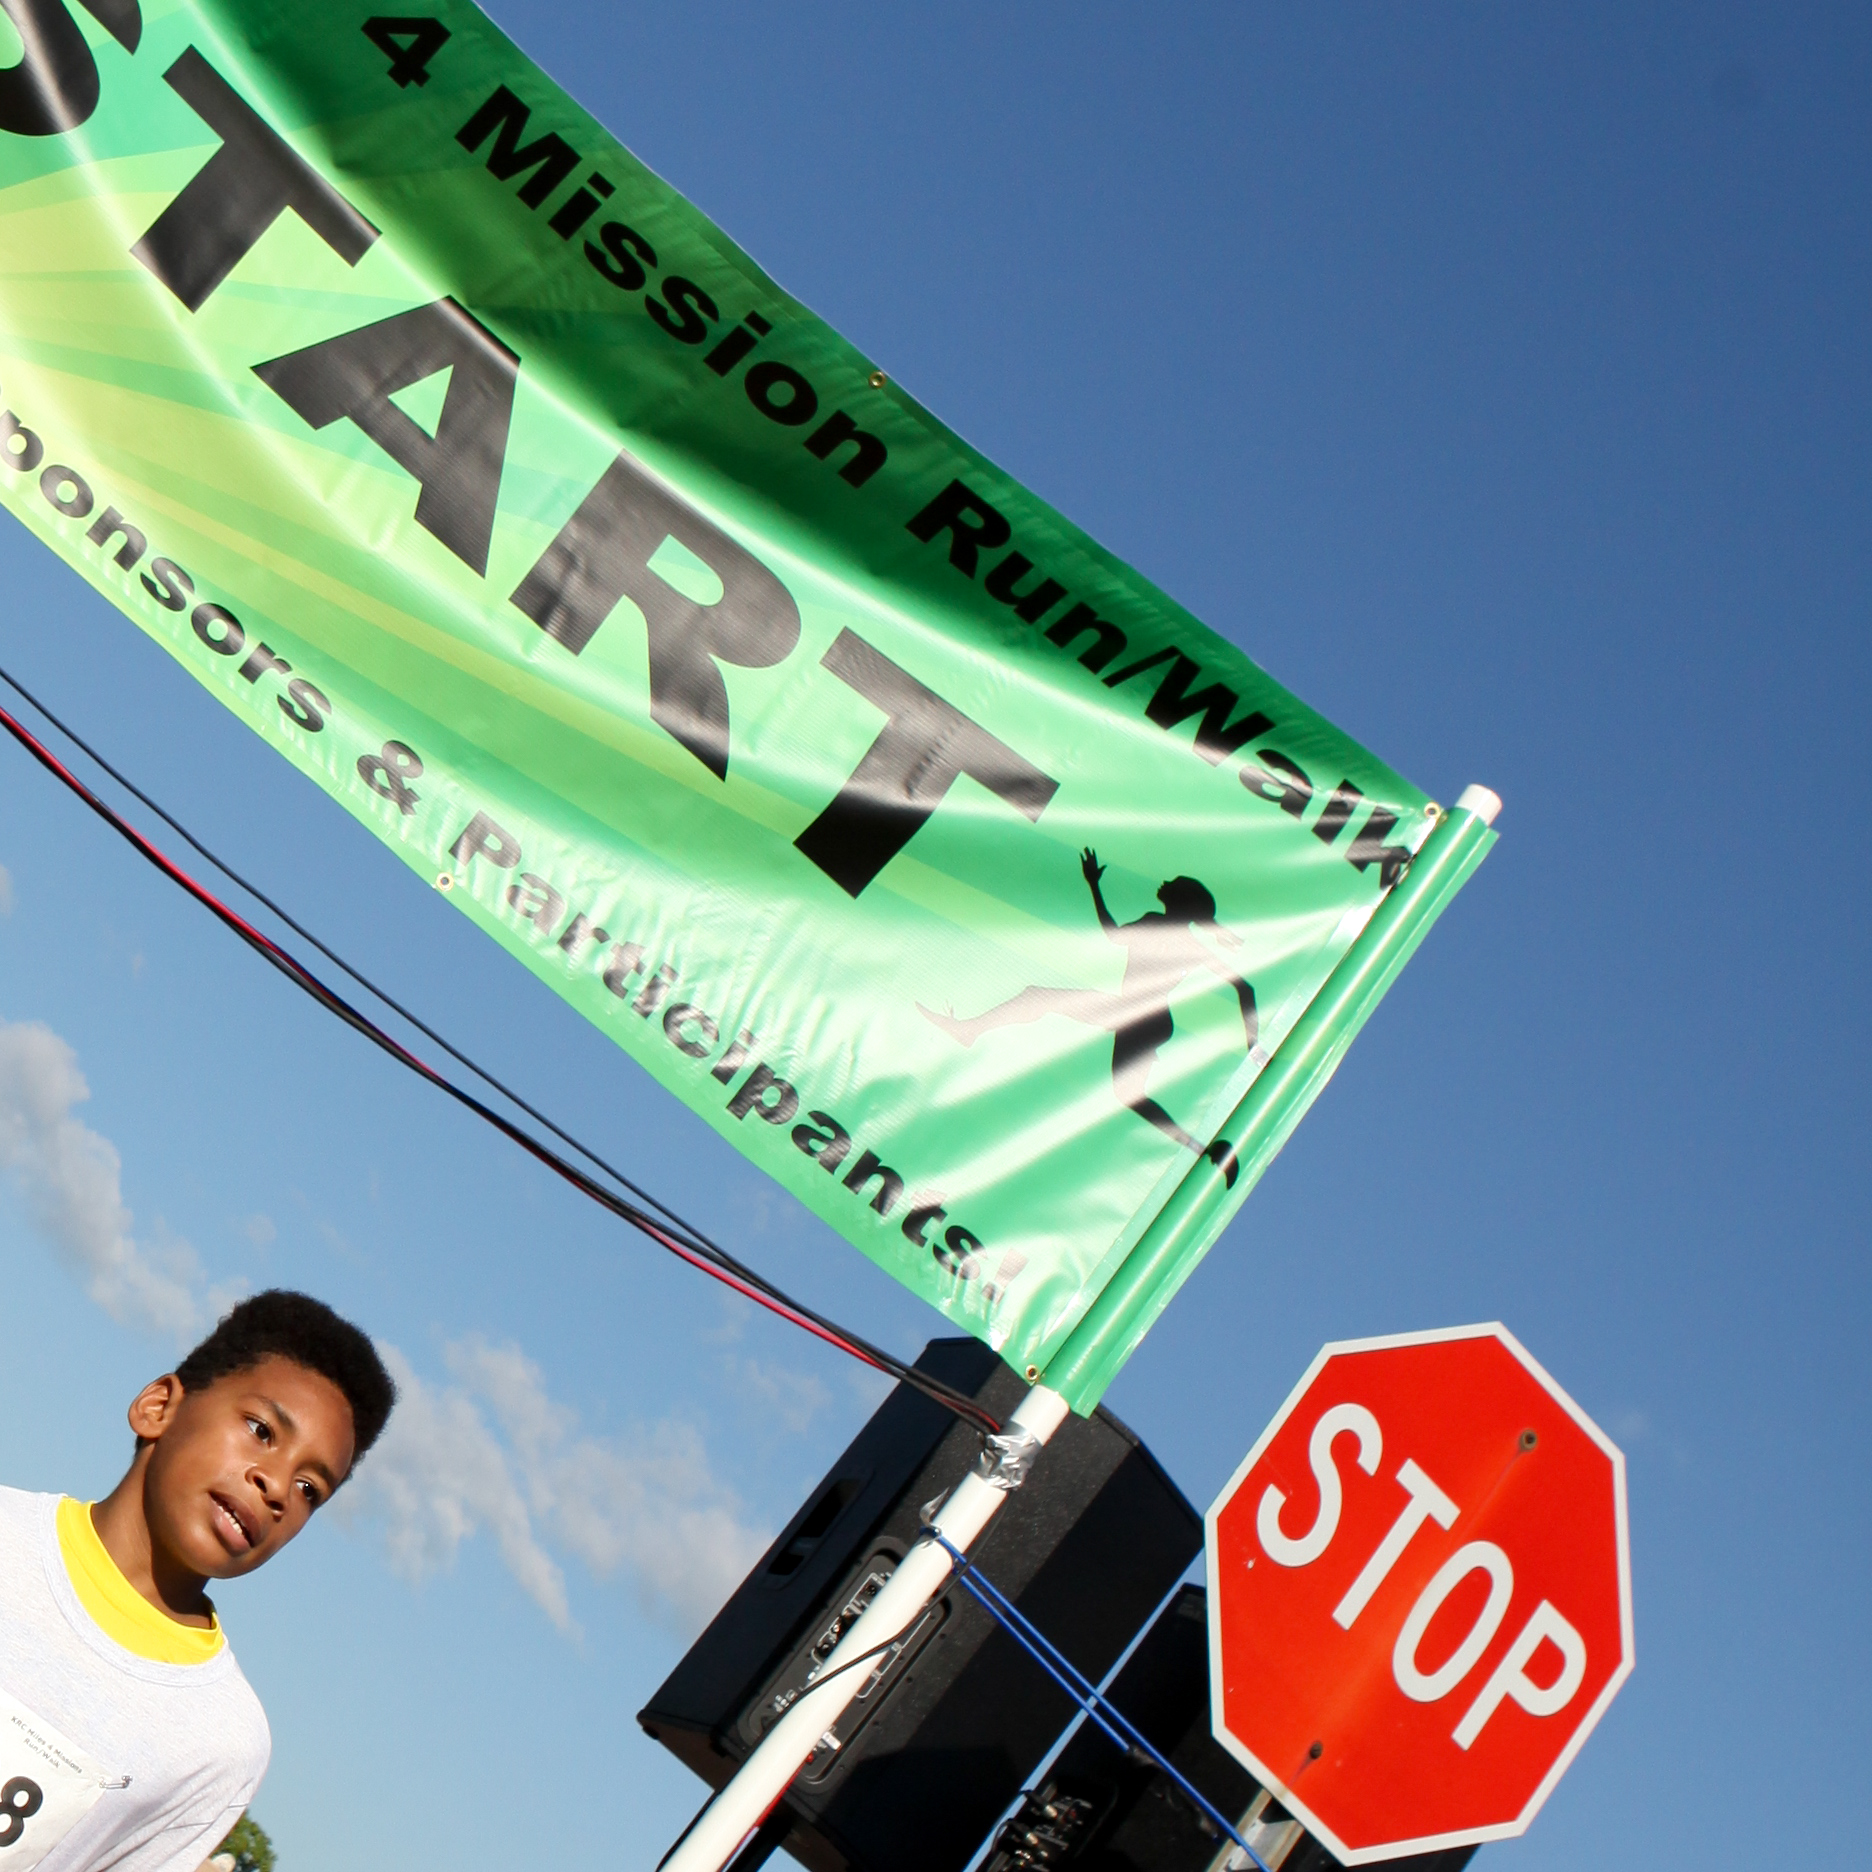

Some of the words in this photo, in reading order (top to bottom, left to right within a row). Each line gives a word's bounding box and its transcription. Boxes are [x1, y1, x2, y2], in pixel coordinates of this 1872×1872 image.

[360, 14, 452, 88] 4
[454, 85, 890, 488] Mission
[904, 479, 1414, 890] Run/Walk
[356, 739, 424, 817] &
[449, 809, 1029, 1305] Participants!
[11, 1716, 28, 1731] KRC
[27, 1728, 46, 1747] Miles
[1257, 1403, 1587, 1750] STOP
[23, 1737, 60, 1769] Run/Walk
